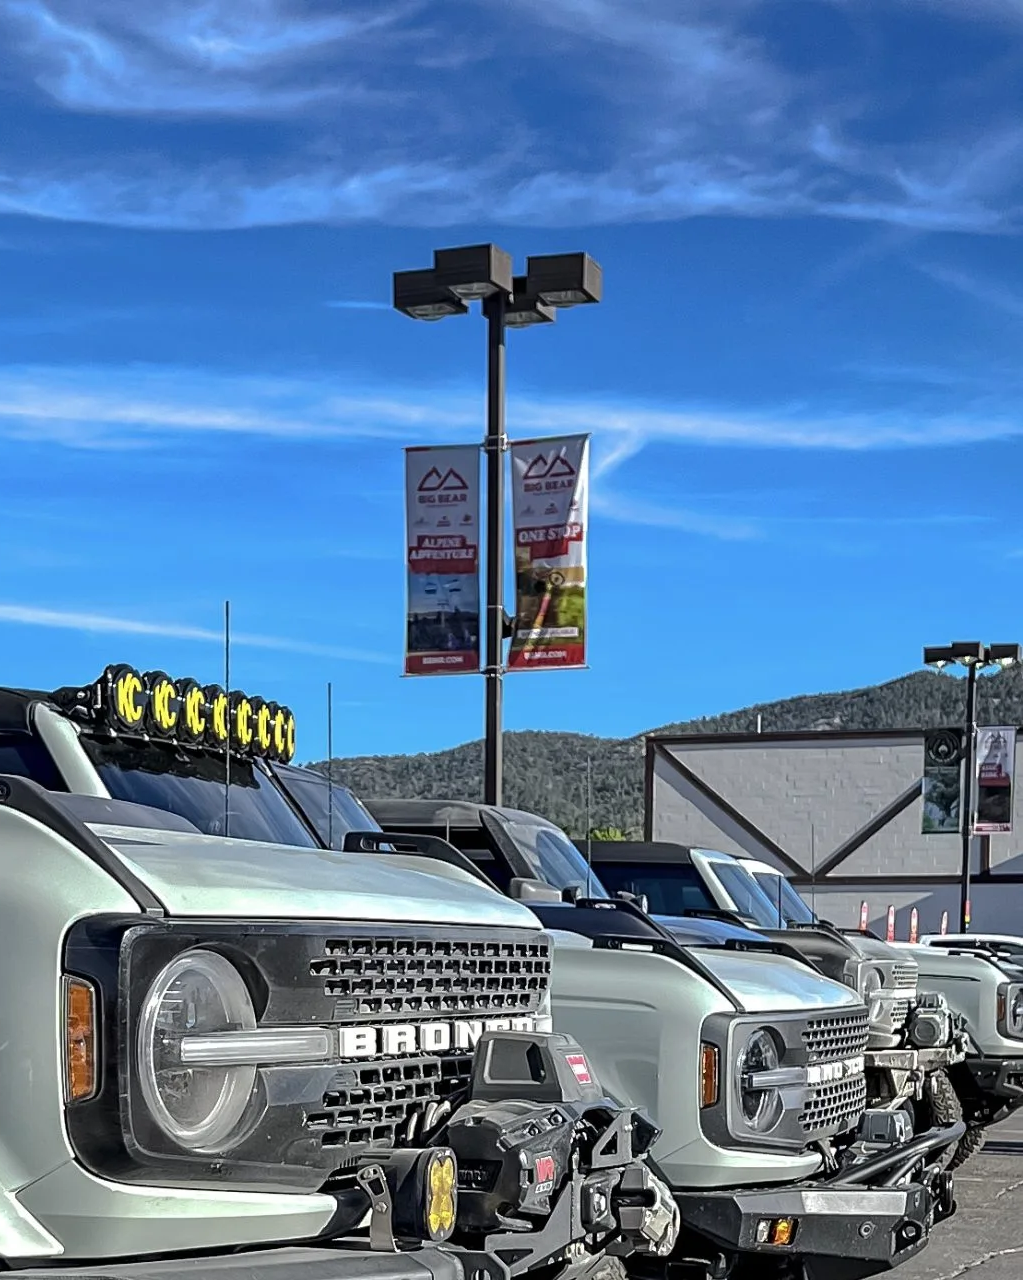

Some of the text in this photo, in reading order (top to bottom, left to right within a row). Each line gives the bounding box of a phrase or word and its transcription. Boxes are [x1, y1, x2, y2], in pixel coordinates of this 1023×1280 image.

[418, 494, 467, 504] BIG BEAR
[524, 479, 574, 492] BIG BEAR
[422, 538, 462, 547] ALPINE
[519, 525, 581, 543] ONE STOP
[409, 549, 474, 560] ADVENTURE
[118, 673, 142, 723] KC
[155, 680, 176, 729] KC
[186, 687, 205, 734] KC
[237, 699, 252, 745] KC
[258, 705, 271, 749] KC
